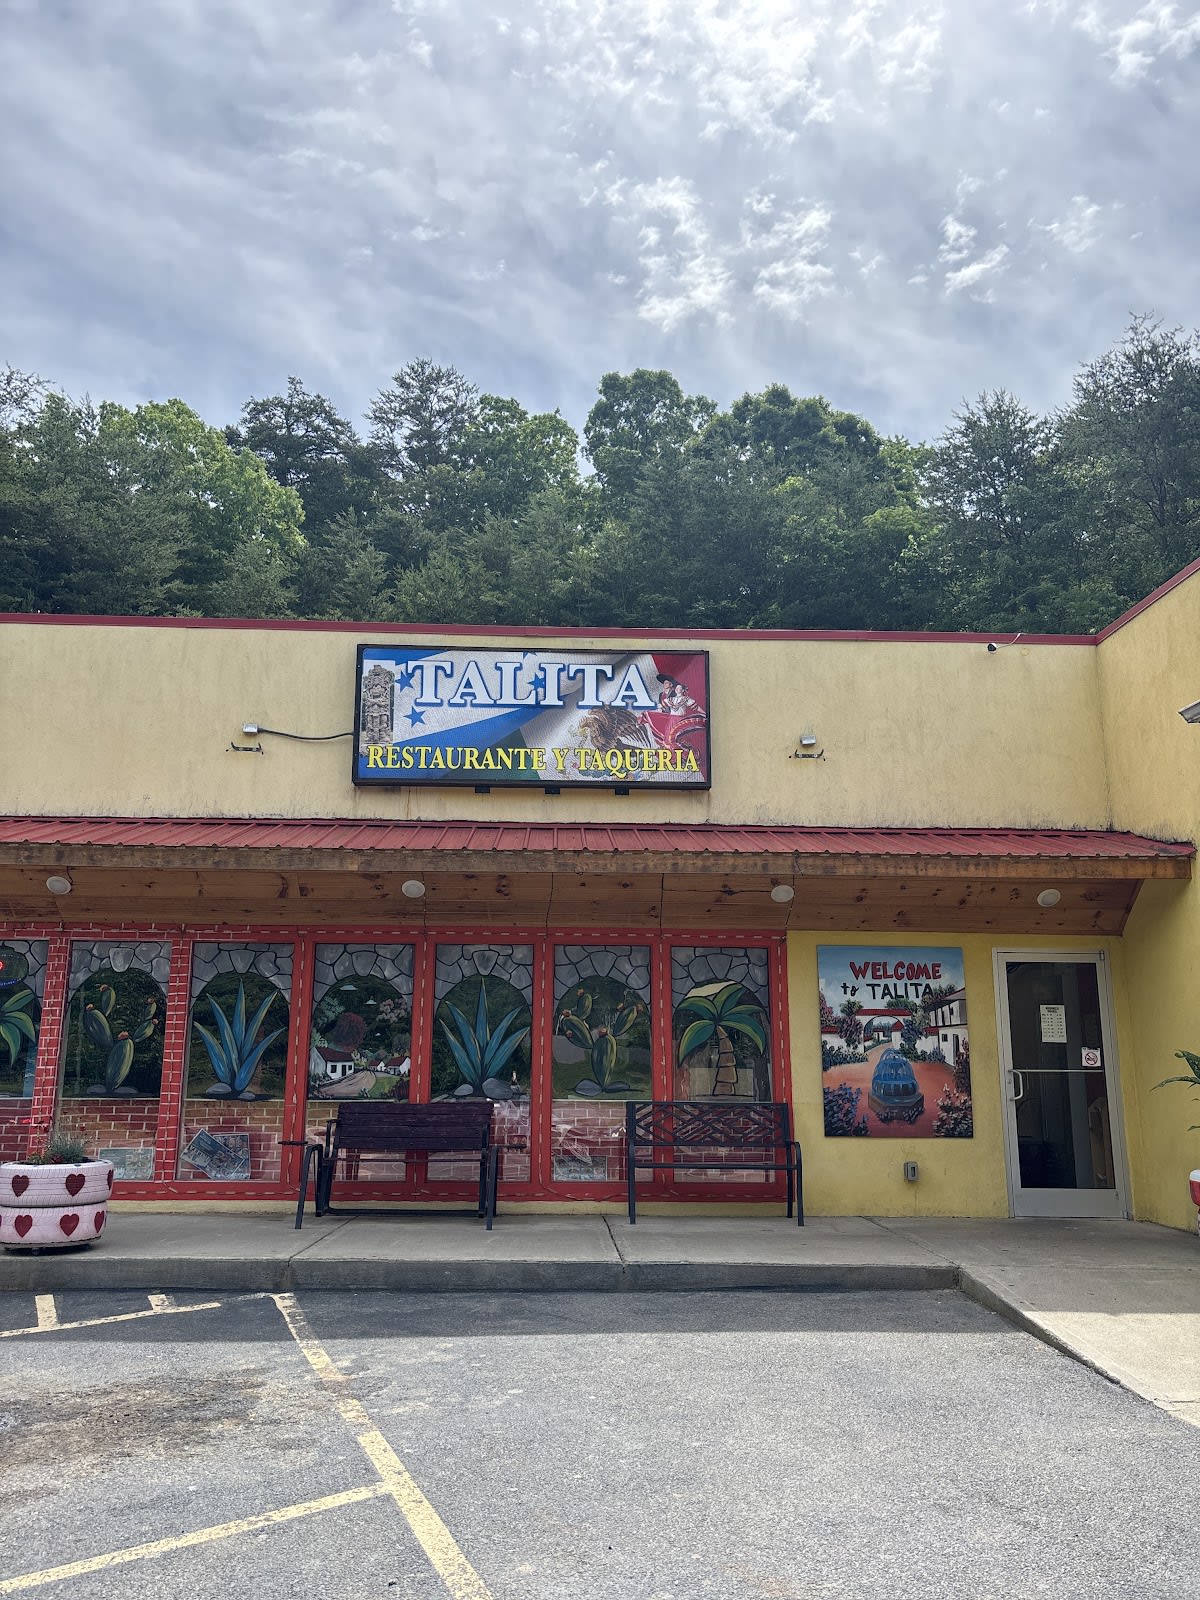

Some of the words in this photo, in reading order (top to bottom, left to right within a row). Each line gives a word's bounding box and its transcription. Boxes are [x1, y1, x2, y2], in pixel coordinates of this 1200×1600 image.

[407, 660, 658, 708] TALITA
[366, 745, 547, 770] RESTAURANTE
[552, 748, 570, 771] Y
[574, 748, 700, 779] TAQUERIA
[849, 961, 942, 981] WELCOME
[840, 982, 860, 997] to
[866, 982, 934, 1000] TALITA
